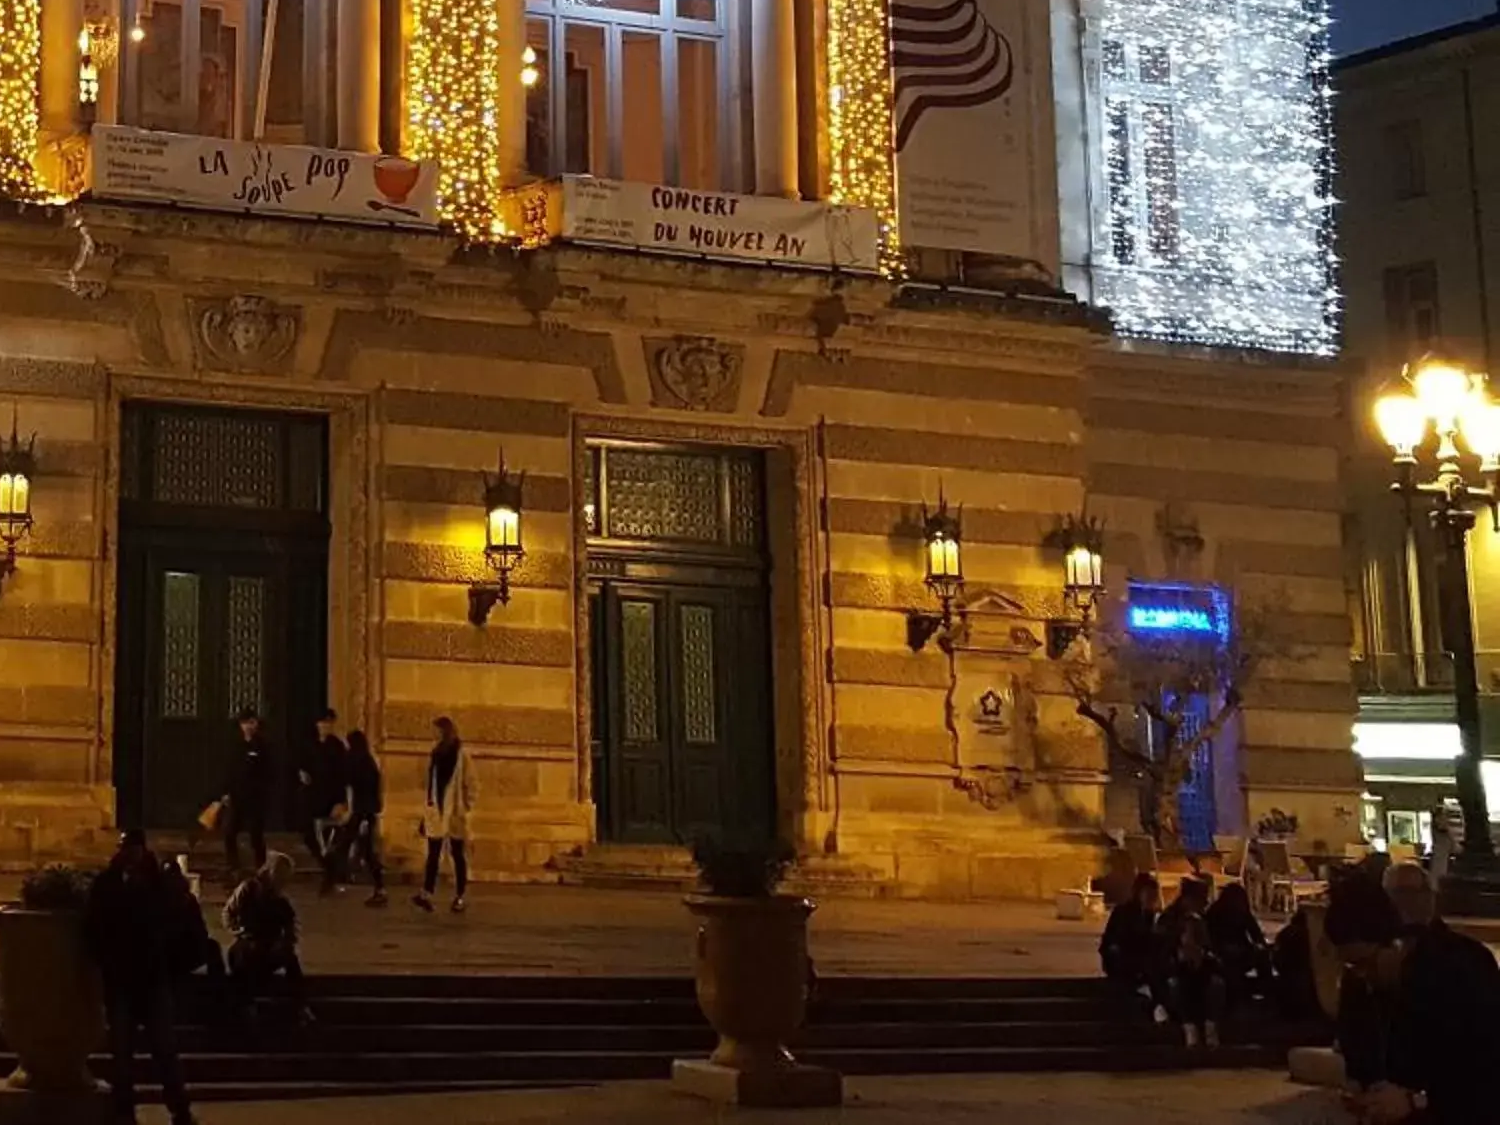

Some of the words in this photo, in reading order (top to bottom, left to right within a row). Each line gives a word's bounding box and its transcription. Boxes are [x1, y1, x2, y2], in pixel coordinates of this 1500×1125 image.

[199, 150, 229, 176] LA
[233, 171, 296, 205] SOUPE
[651, 186, 740, 217] CONCERT
[654, 222, 678, 243] DU
[689, 224, 765, 252] NOUVEL
[773, 232, 807, 257] AN
